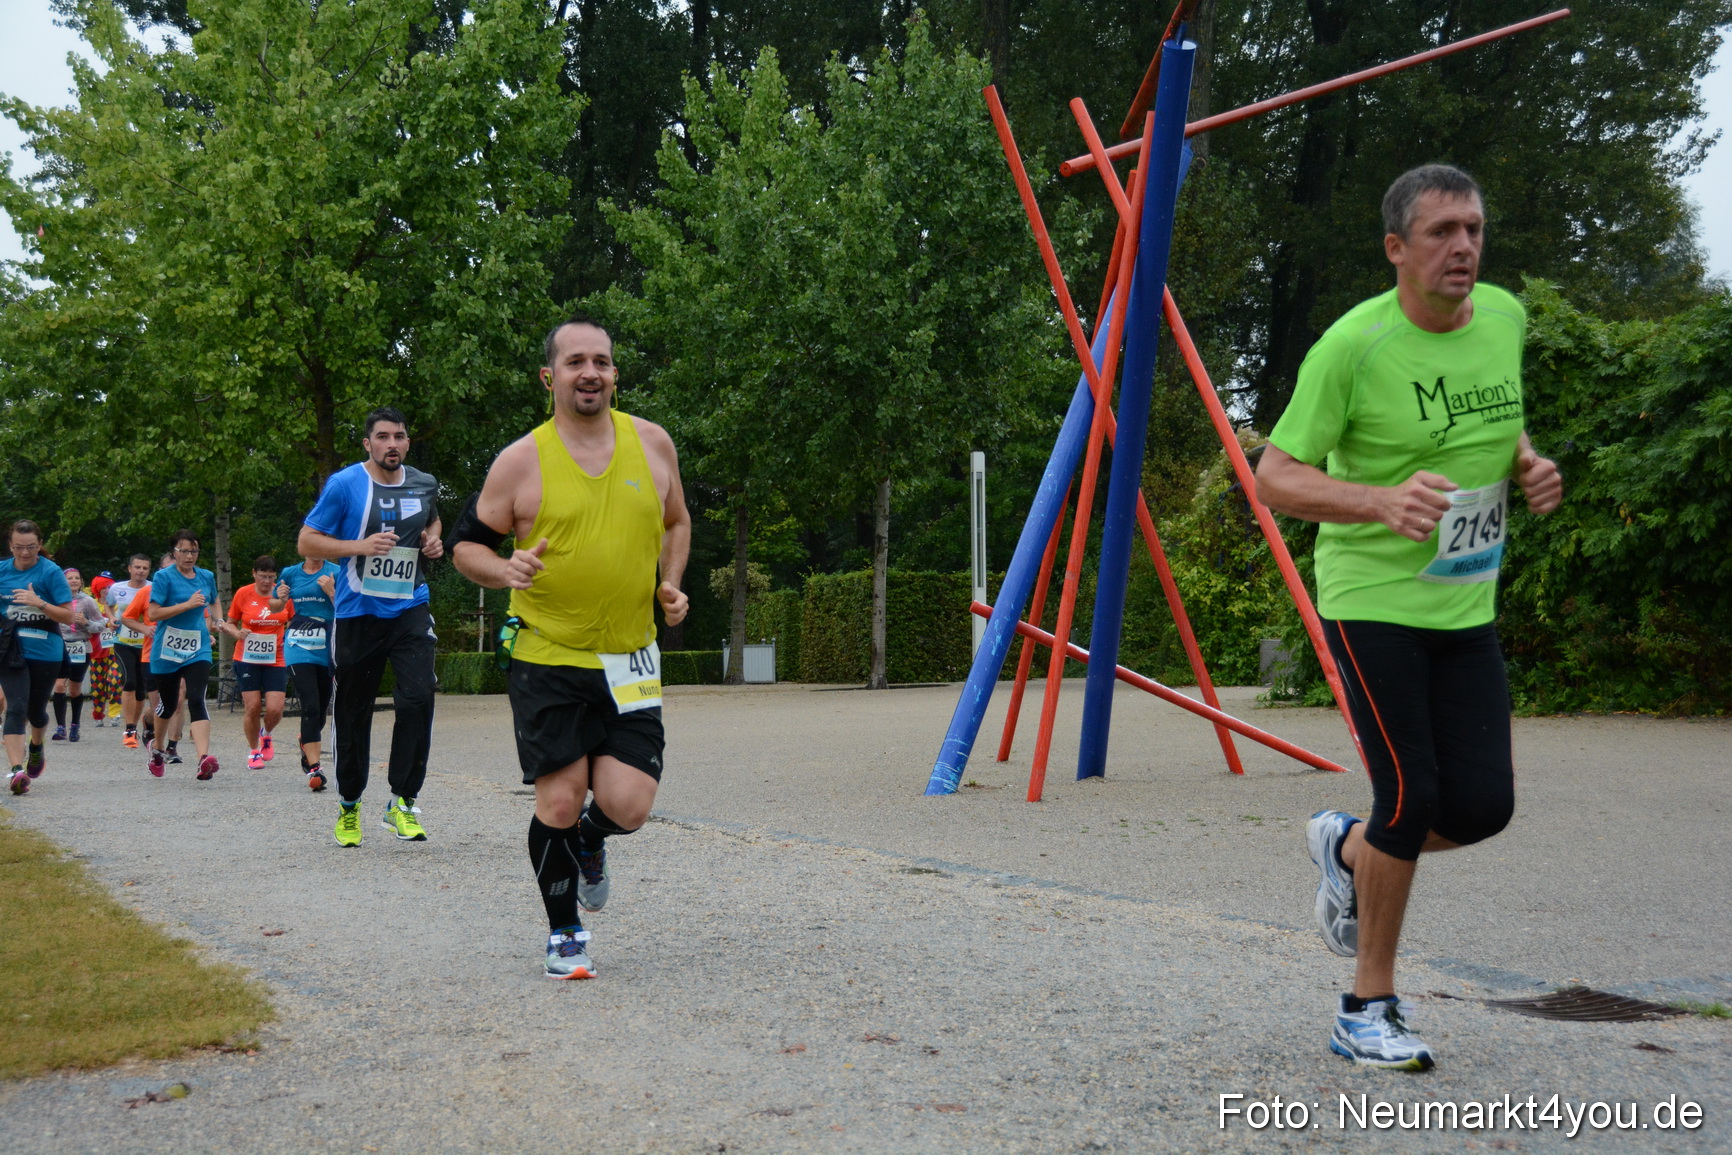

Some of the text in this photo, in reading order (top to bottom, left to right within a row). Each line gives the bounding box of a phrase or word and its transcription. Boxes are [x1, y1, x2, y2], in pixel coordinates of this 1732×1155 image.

[1410, 376, 1519, 421] Marion's
[1447, 501, 1502, 553] 2149
[370, 557, 414, 579] 3040
[1450, 553, 1493, 574] Michael
[166, 635, 198, 652] 2329
[247, 640, 274, 653] 2295
[630, 648, 655, 676] 40
